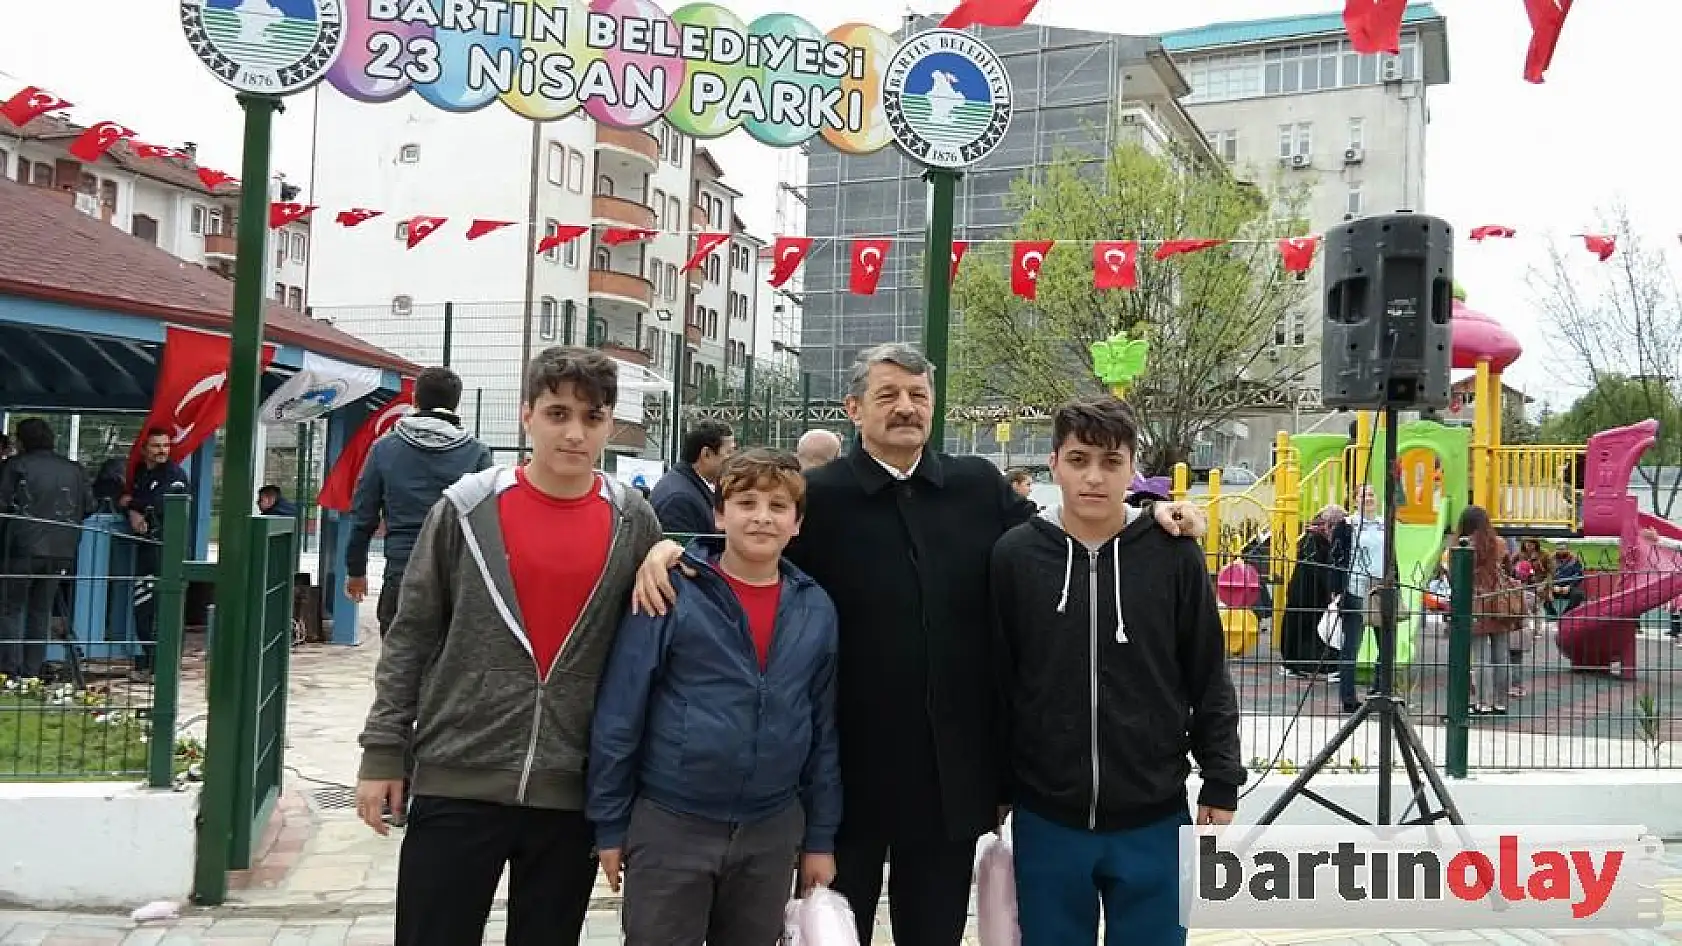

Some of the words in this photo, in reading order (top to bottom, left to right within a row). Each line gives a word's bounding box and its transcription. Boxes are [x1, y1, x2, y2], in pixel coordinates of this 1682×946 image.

[367, 0, 567, 48] BARTIN
[241, 70, 274, 86] 1876
[364, 31, 442, 84] 23
[690, 70, 865, 132] PARKI
[932, 147, 958, 162] 1876
